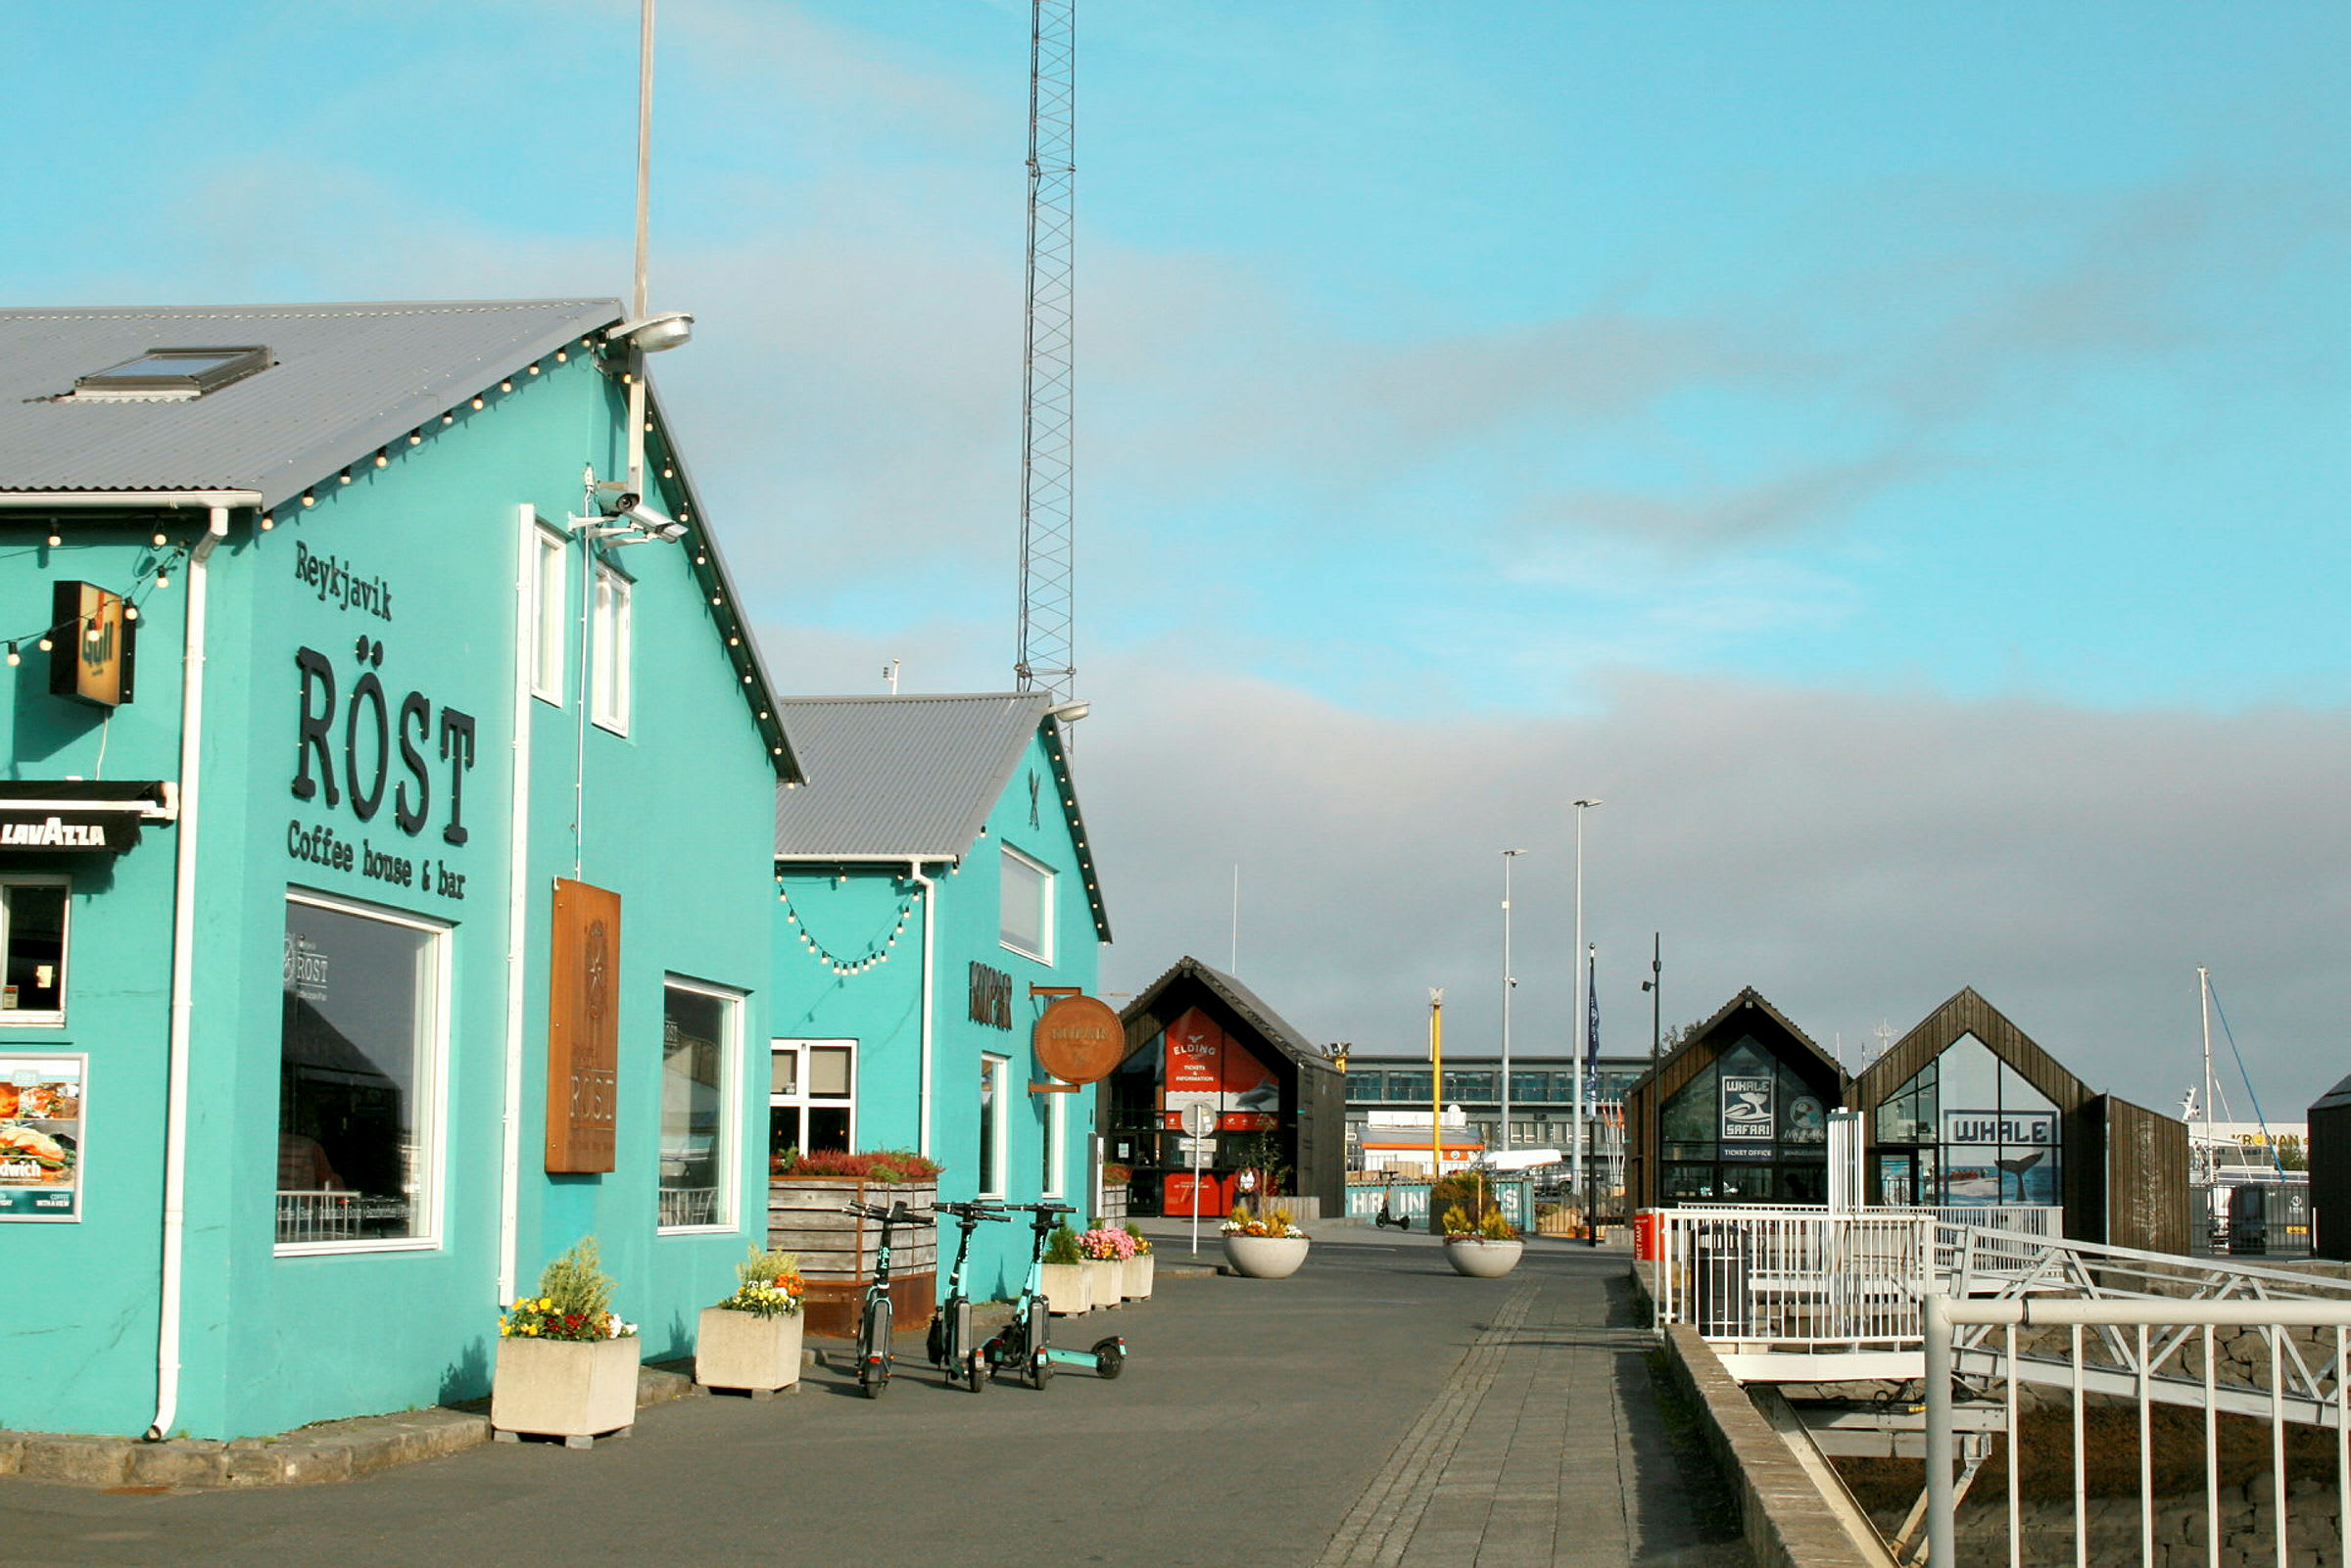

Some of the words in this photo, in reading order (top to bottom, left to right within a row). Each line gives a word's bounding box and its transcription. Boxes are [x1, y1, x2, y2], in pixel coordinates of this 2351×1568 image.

[296, 540, 392, 622] Reykjavik
[292, 635, 476, 847] RÖST
[1, 817, 107, 846] LAVAZZA
[287, 819, 354, 872] Coffee
[362, 838, 412, 887] house
[437, 859, 466, 900] bar
[1173, 1044, 1216, 1056] ELDING
[1726, 1081, 1770, 1091] WHALE
[1726, 1124, 1770, 1136] SAFARI
[1954, 1120, 2048, 1143] WHALE
